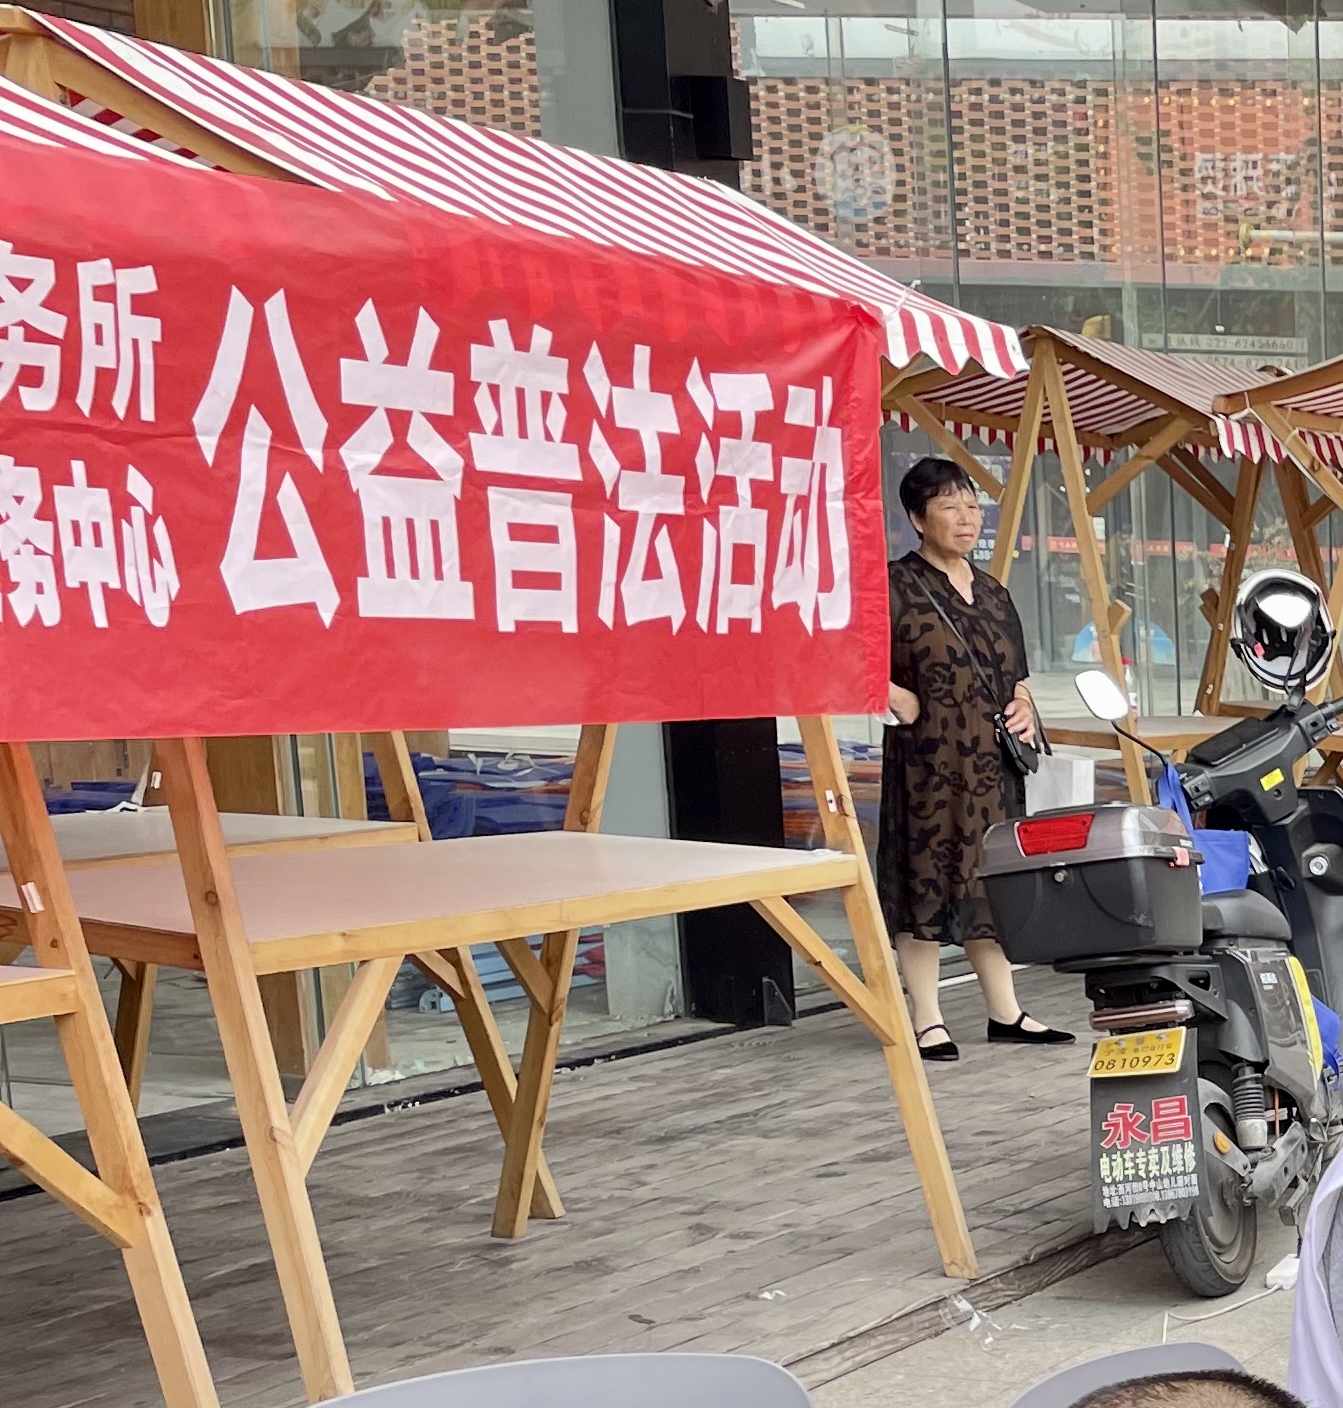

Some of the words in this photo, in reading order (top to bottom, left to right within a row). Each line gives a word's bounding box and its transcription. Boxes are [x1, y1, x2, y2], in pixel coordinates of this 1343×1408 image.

[192, 284, 853, 637] 公益普法活动
[1094, 1053, 1175, 1071] 0810973
[1100, 1095, 1193, 1149] 永昌
[1099, 1144, 1197, 1183] 电动车专卖及维修
